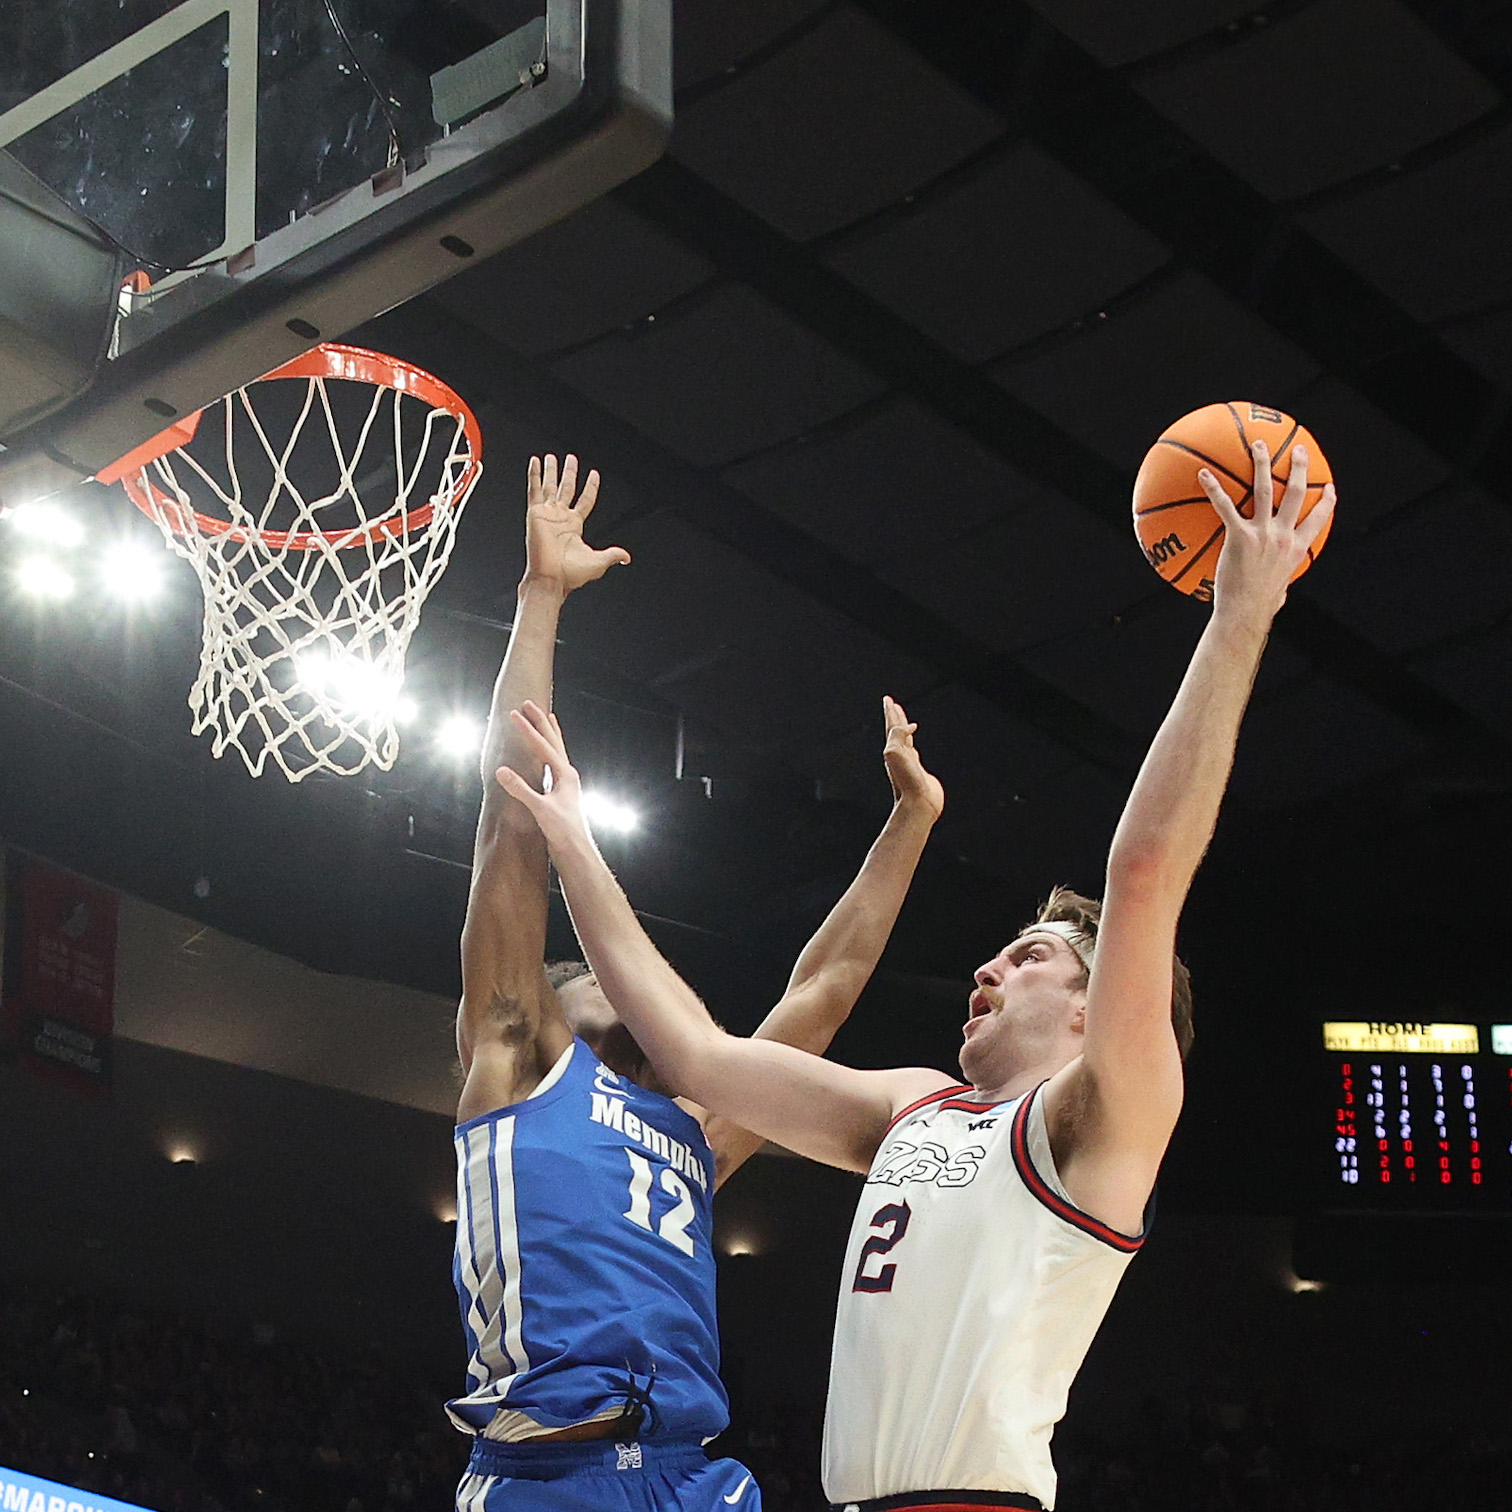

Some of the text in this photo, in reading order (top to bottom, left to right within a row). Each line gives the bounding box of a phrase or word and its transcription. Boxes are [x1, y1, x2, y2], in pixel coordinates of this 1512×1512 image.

[1369, 1022, 1432, 1036] HOME
[621, 1145, 696, 1257] 12
[852, 1198, 911, 1293] 2
